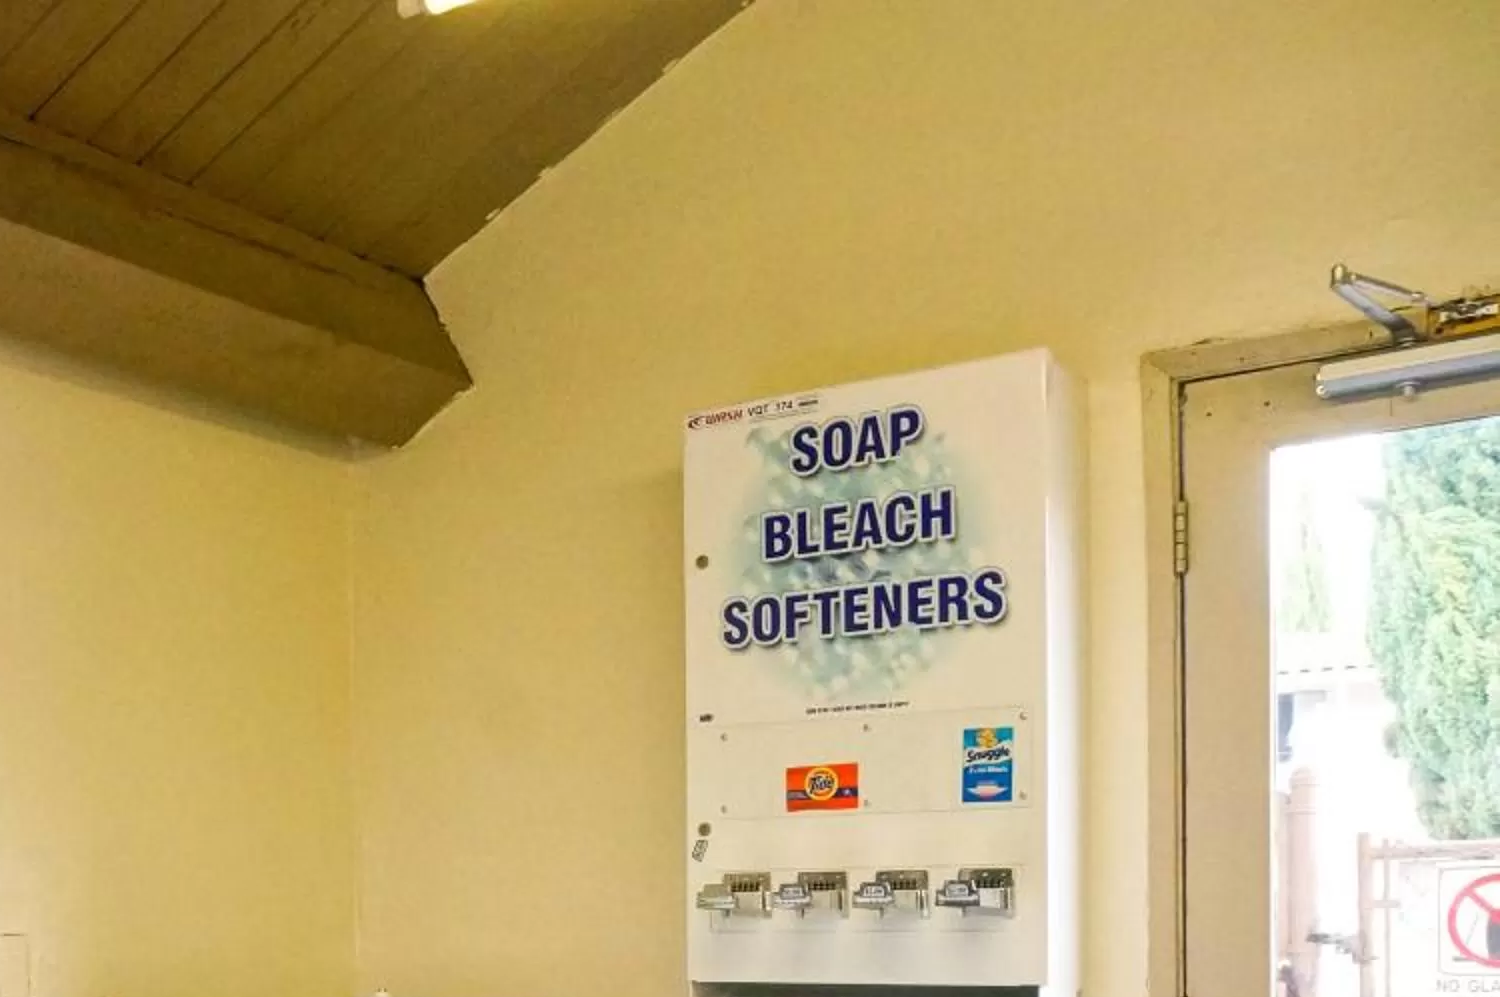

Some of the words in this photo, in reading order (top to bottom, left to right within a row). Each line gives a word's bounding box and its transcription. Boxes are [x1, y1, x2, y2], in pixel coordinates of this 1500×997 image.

[790, 406, 922, 475] SOAP
[762, 487, 953, 561] BLEACH
[721, 569, 1005, 647] SOFTENERS
[966, 745, 1010, 762] Snuggle
[810, 775, 835, 794] Tide
[1436, 979, 1460, 992] NO
